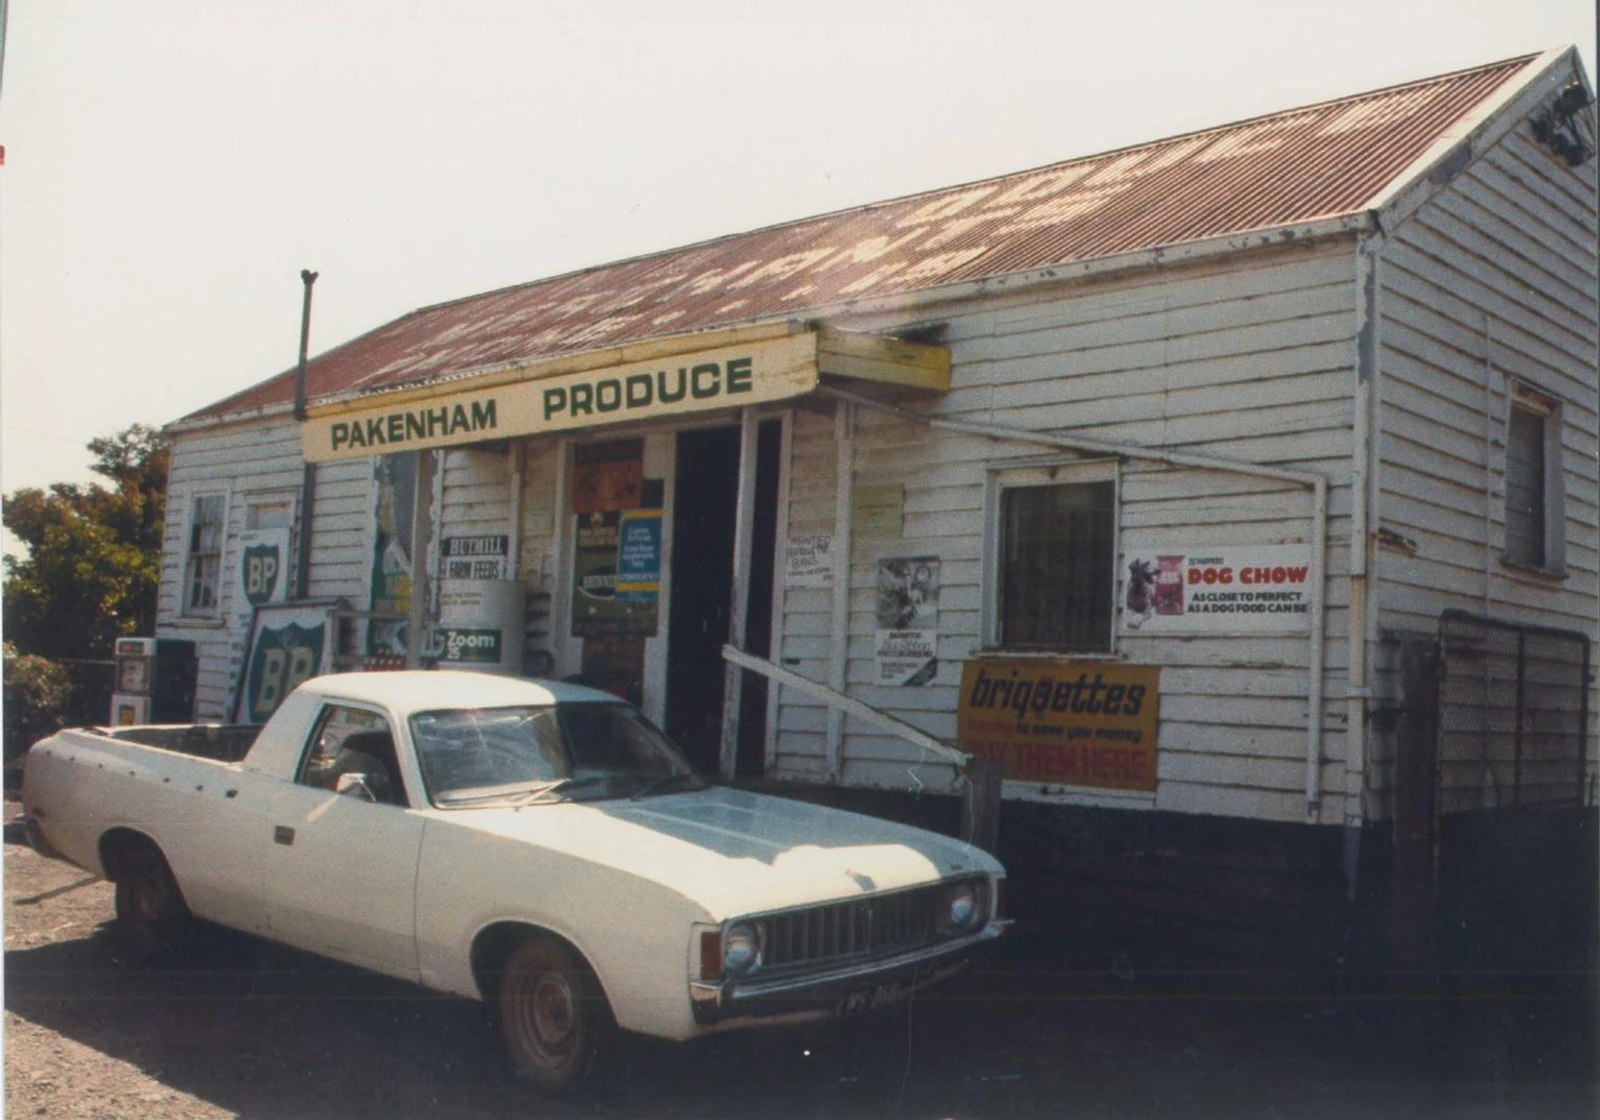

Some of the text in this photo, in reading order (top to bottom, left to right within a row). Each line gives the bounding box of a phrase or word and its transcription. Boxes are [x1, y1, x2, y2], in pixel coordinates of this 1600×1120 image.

[331, 358, 753, 451] PAKENHAM PRODUCE
[247, 556, 277, 595] BP
[475, 559, 500, 579] FEEDS
[1187, 567, 1234, 585] DOG
[1239, 566, 1308, 584] CHOW
[1192, 591, 1303, 602] AS CLOSE TO PERFECT
[1187, 603, 1308, 613] AS A DOG FOOD CAN BE
[446, 631, 496, 649] Zoom
[254, 646, 314, 713] BP
[1012, 741, 1078, 776] THEM
[1081, 745, 1147, 782] HERE
